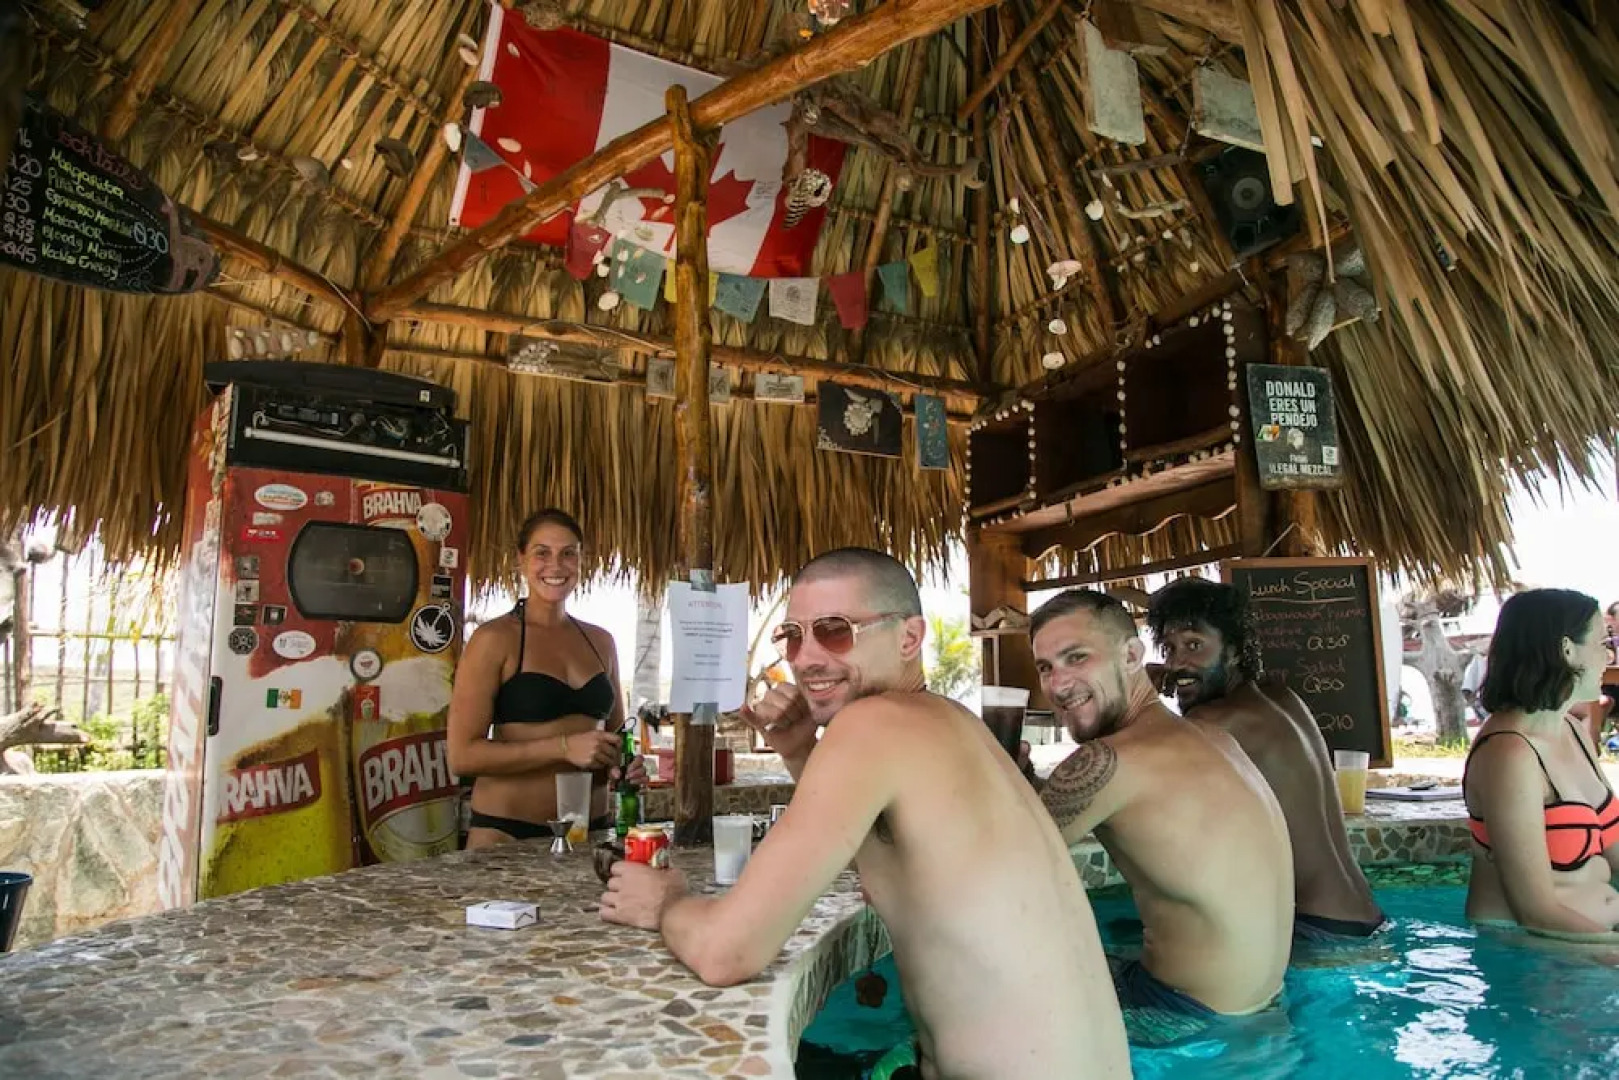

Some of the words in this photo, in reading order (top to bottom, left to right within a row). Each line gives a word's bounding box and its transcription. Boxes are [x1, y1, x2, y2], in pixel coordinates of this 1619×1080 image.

[49, 146, 125, 201] Margarita
[1265, 381, 1316, 398] DONALD
[1269, 397, 1299, 412] ERES
[1300, 399, 1317, 414] UN
[1270, 412, 1318, 427] PENDEJO
[363, 491, 421, 519] BRAHVA
[1248, 573, 1291, 597] Lunch
[1293, 571, 1355, 600] Special
[217, 763, 315, 818] RAHVA
